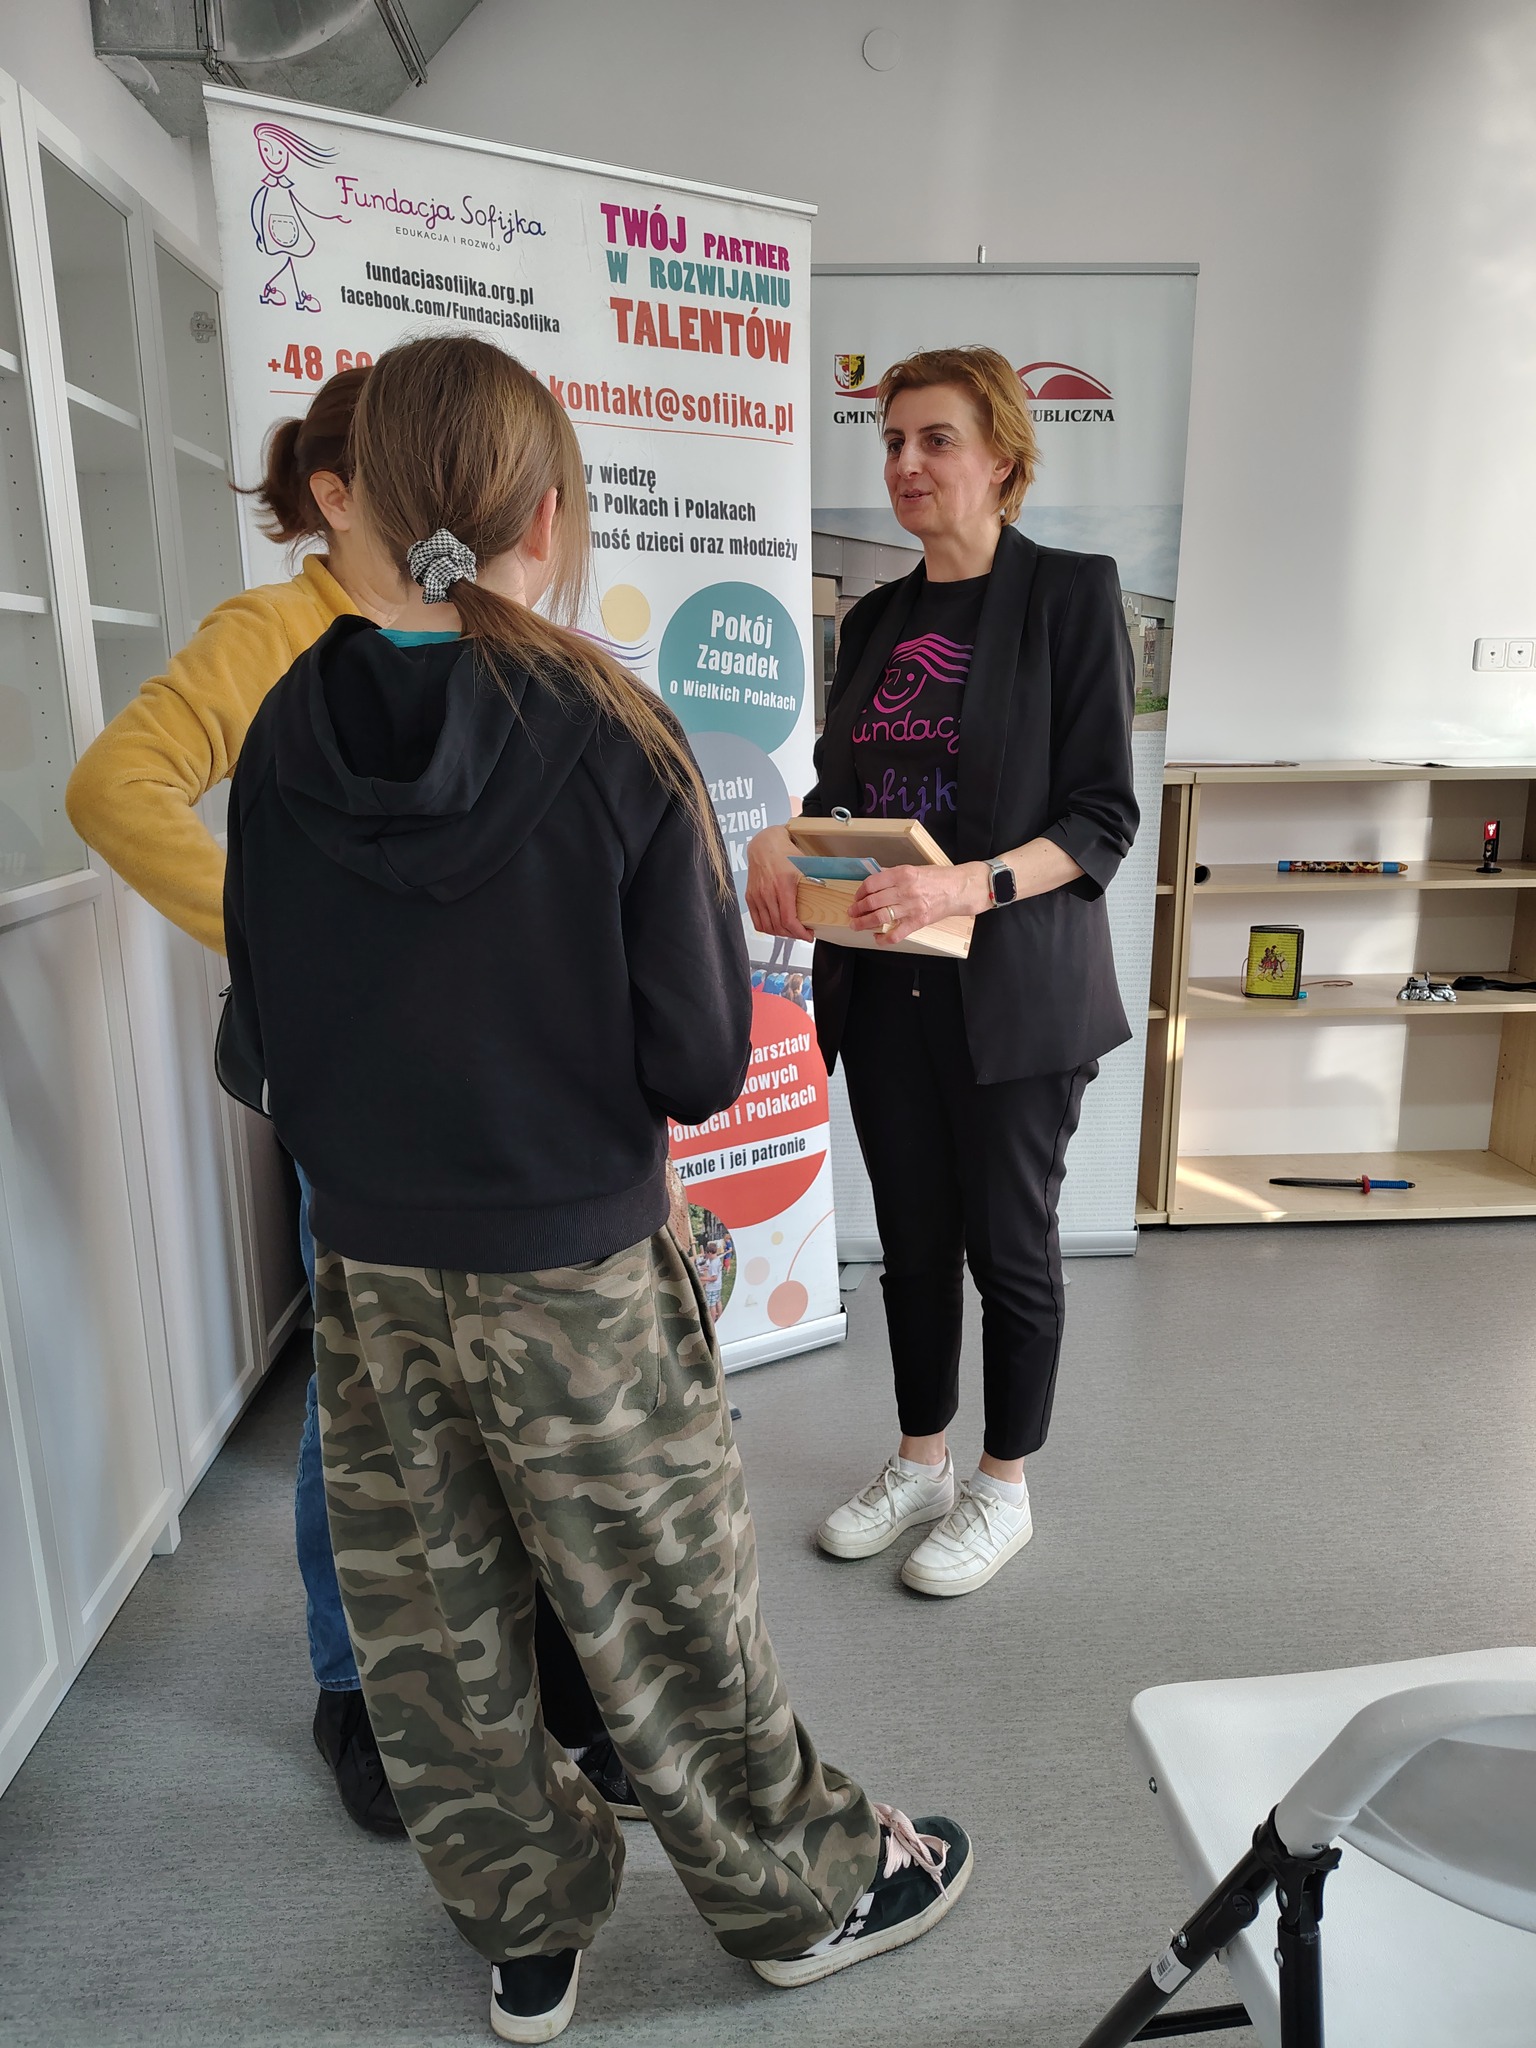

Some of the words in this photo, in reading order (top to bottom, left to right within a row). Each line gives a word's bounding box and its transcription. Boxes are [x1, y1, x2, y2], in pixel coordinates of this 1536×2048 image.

[335, 175, 455, 229] Fundacja
[460, 195, 547, 243] Sofijka
[395, 226, 450, 243] EDUKACJA
[453, 236, 457, 244] I
[460, 236, 501, 252] ROZWÓJ
[600, 203, 687, 254] TWÓJ
[703, 232, 790, 272] PARTNER
[365, 261, 534, 306] fundacjasofijka.org.pl
[605, 250, 628, 284] W
[649, 256, 791, 308] ROZWIJANIU
[340, 286, 561, 333] facebook.com/FundacjaSofijka
[609, 296, 791, 365] TALENTÓW
[267, 343, 323, 381] +48
[549, 375, 794, 435] kontakt@sofijka.pl
[1029, 409, 1115, 422] UBLICZNA
[600, 463, 656, 494] wiedzę
[604, 493, 668, 517] Polkach
[674, 497, 680, 518] i
[685, 498, 756, 522] Polakach
[636, 531, 684, 553] dzieci
[690, 535, 724, 555] oraz
[729, 535, 798, 562] młodzieży
[710, 609, 773, 649] Pokój
[696, 643, 779, 680] Zagadek
[669, 679, 678, 694] o
[683, 679, 740, 703] Wielkich
[744, 688, 796, 711] Polakach
[734, 1104, 742, 1125] i
[746, 1083, 817, 1122] Polakach
[676, 1158, 716, 1179] zkole
[720, 1153, 725, 1170] i
[729, 1148, 747, 1169] jej
[752, 1136, 806, 1165] patronie
